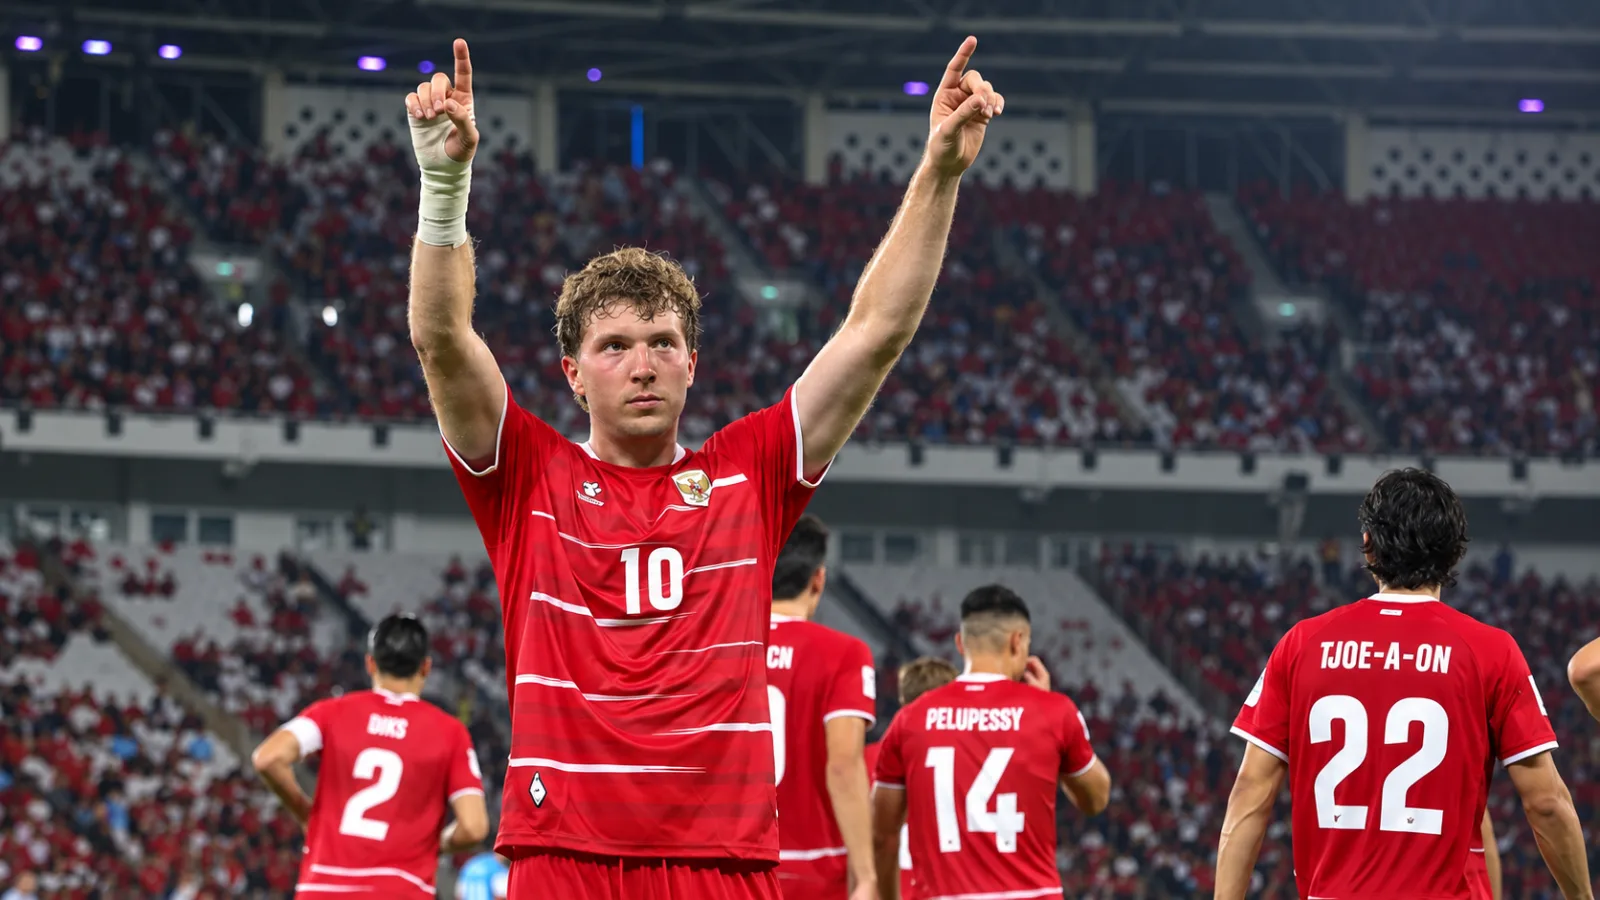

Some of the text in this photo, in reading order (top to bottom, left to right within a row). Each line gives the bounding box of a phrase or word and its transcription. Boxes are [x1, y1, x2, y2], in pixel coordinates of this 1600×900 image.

[620, 547, 684, 615] 10
[1321, 641, 1451, 673] TJOE-A-ON
[367, 712, 409, 739] DIKS
[926, 707, 1023, 731] PELUPESSY
[340, 748, 403, 840] 2
[1309, 695, 1448, 834] 22
[926, 747, 1024, 852] 14
